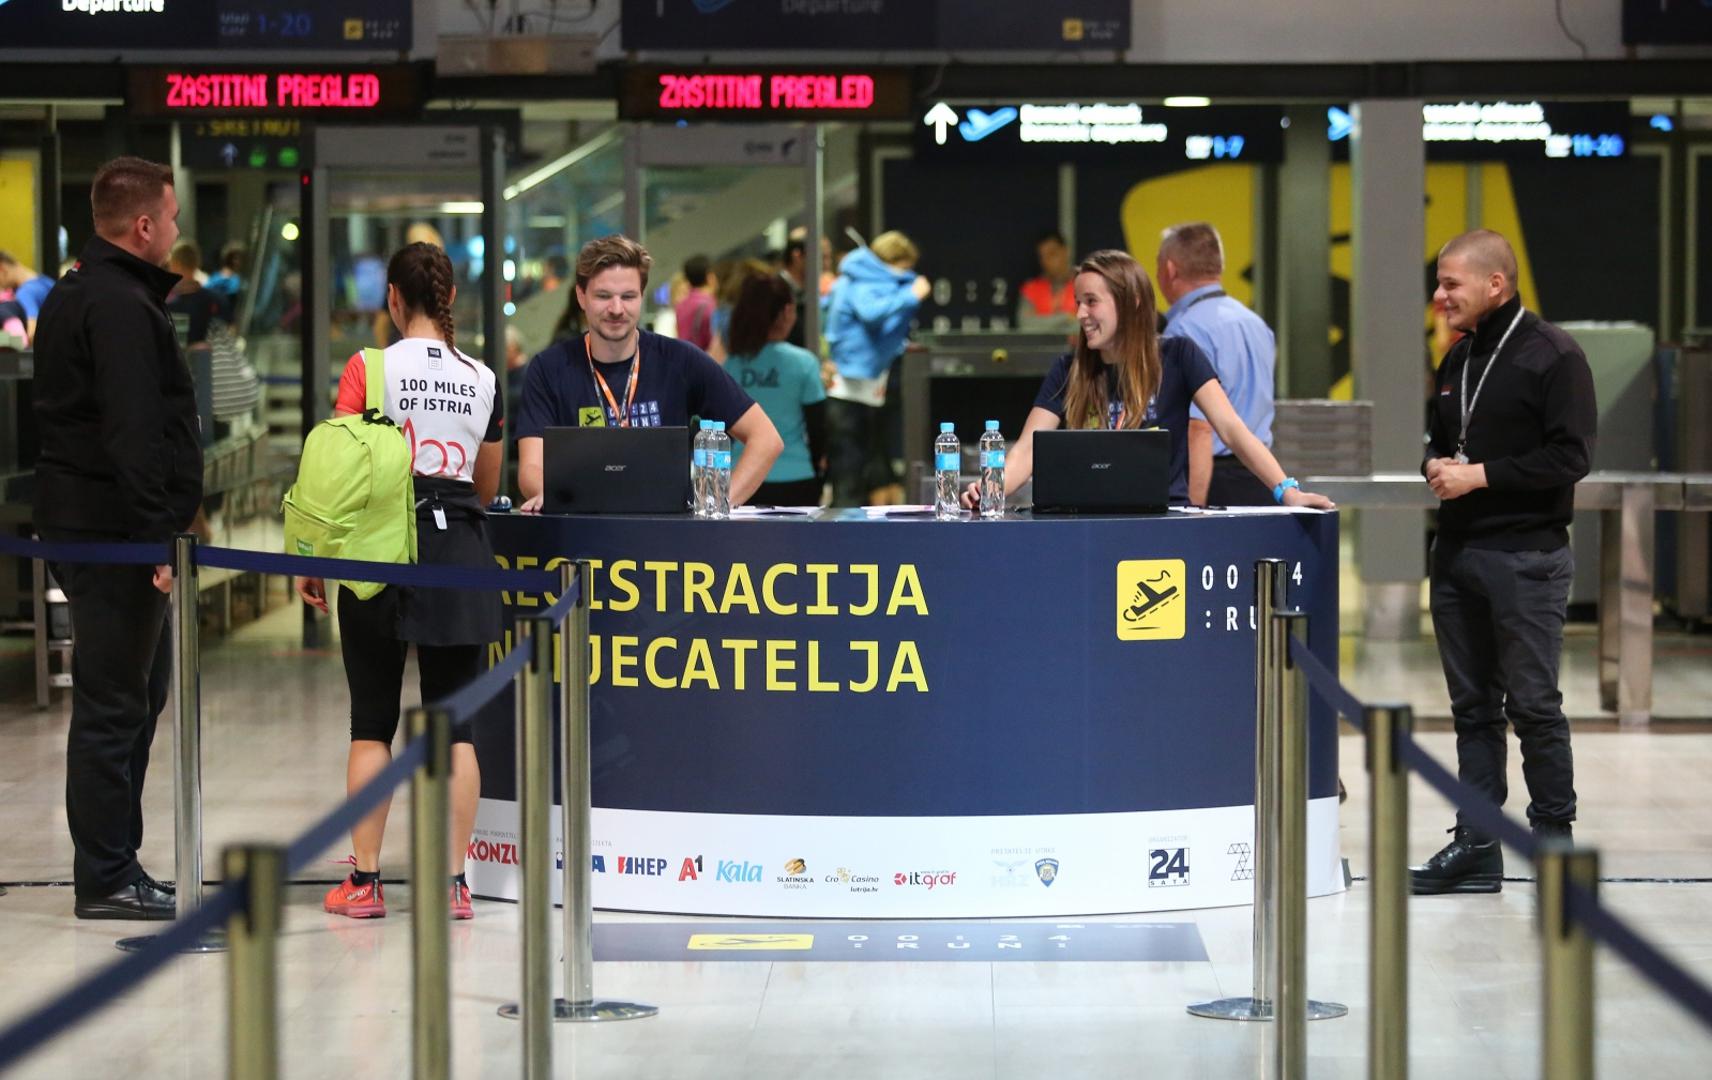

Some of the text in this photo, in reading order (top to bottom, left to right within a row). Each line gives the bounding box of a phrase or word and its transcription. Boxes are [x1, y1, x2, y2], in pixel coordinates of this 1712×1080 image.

[165, 74, 380, 107] ZASTITNI PREGLED
[658, 74, 875, 107] ZASTITNI PREGLED
[400, 378, 476, 398] 100 MILES
[399, 397, 472, 416] OF ISTRIA
[604, 464, 627, 472] acer
[1090, 462, 1113, 471] acer
[635, 857, 667, 876] HEP
[679, 854, 704, 881] A1
[716, 860, 763, 883] Kala
[1149, 848, 1189, 879] 24
[825, 875, 879, 883] Cro Casino
